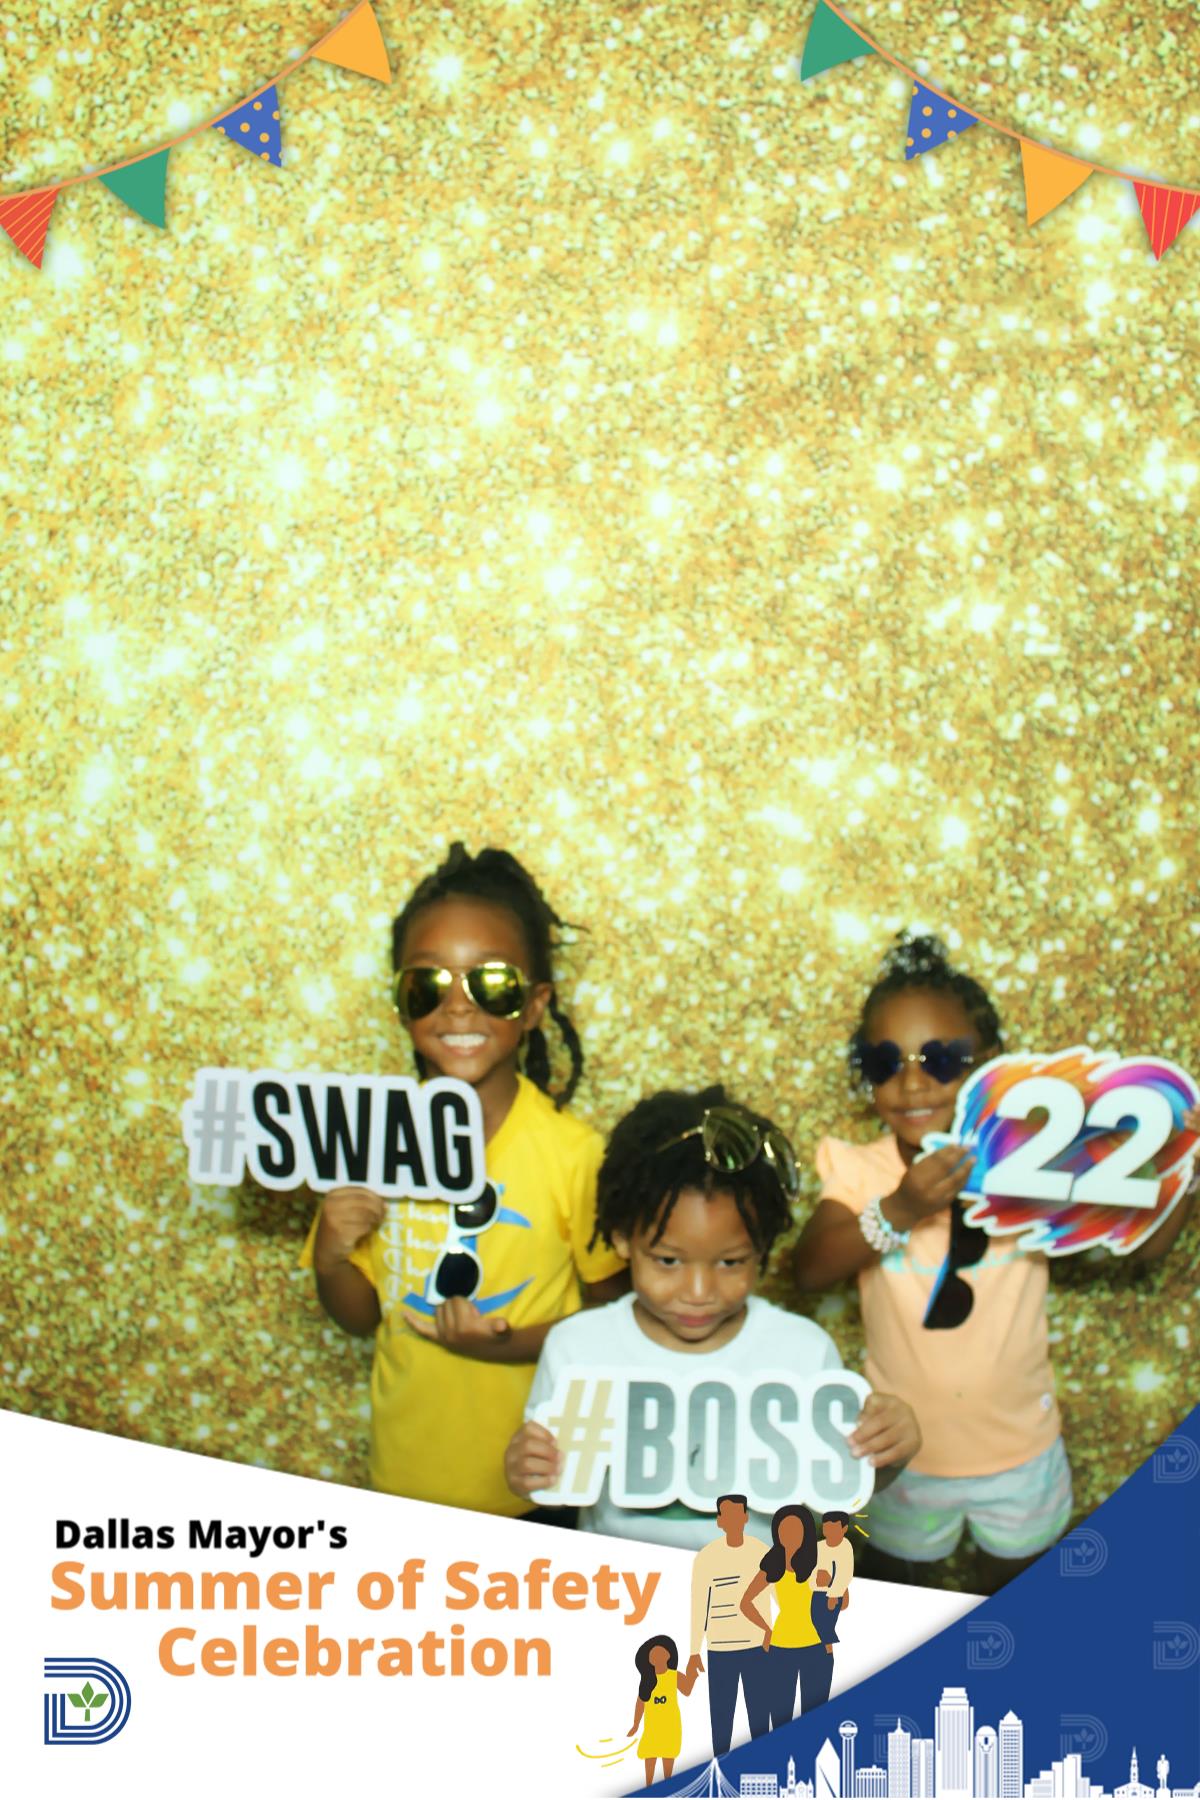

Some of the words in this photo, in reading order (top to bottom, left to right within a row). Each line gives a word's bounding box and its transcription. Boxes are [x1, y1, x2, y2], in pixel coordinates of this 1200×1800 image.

[193, 1079, 474, 1191] #SWAG
[981, 1076, 1173, 1209] 22
[547, 1379, 862, 1502] #BOSS
